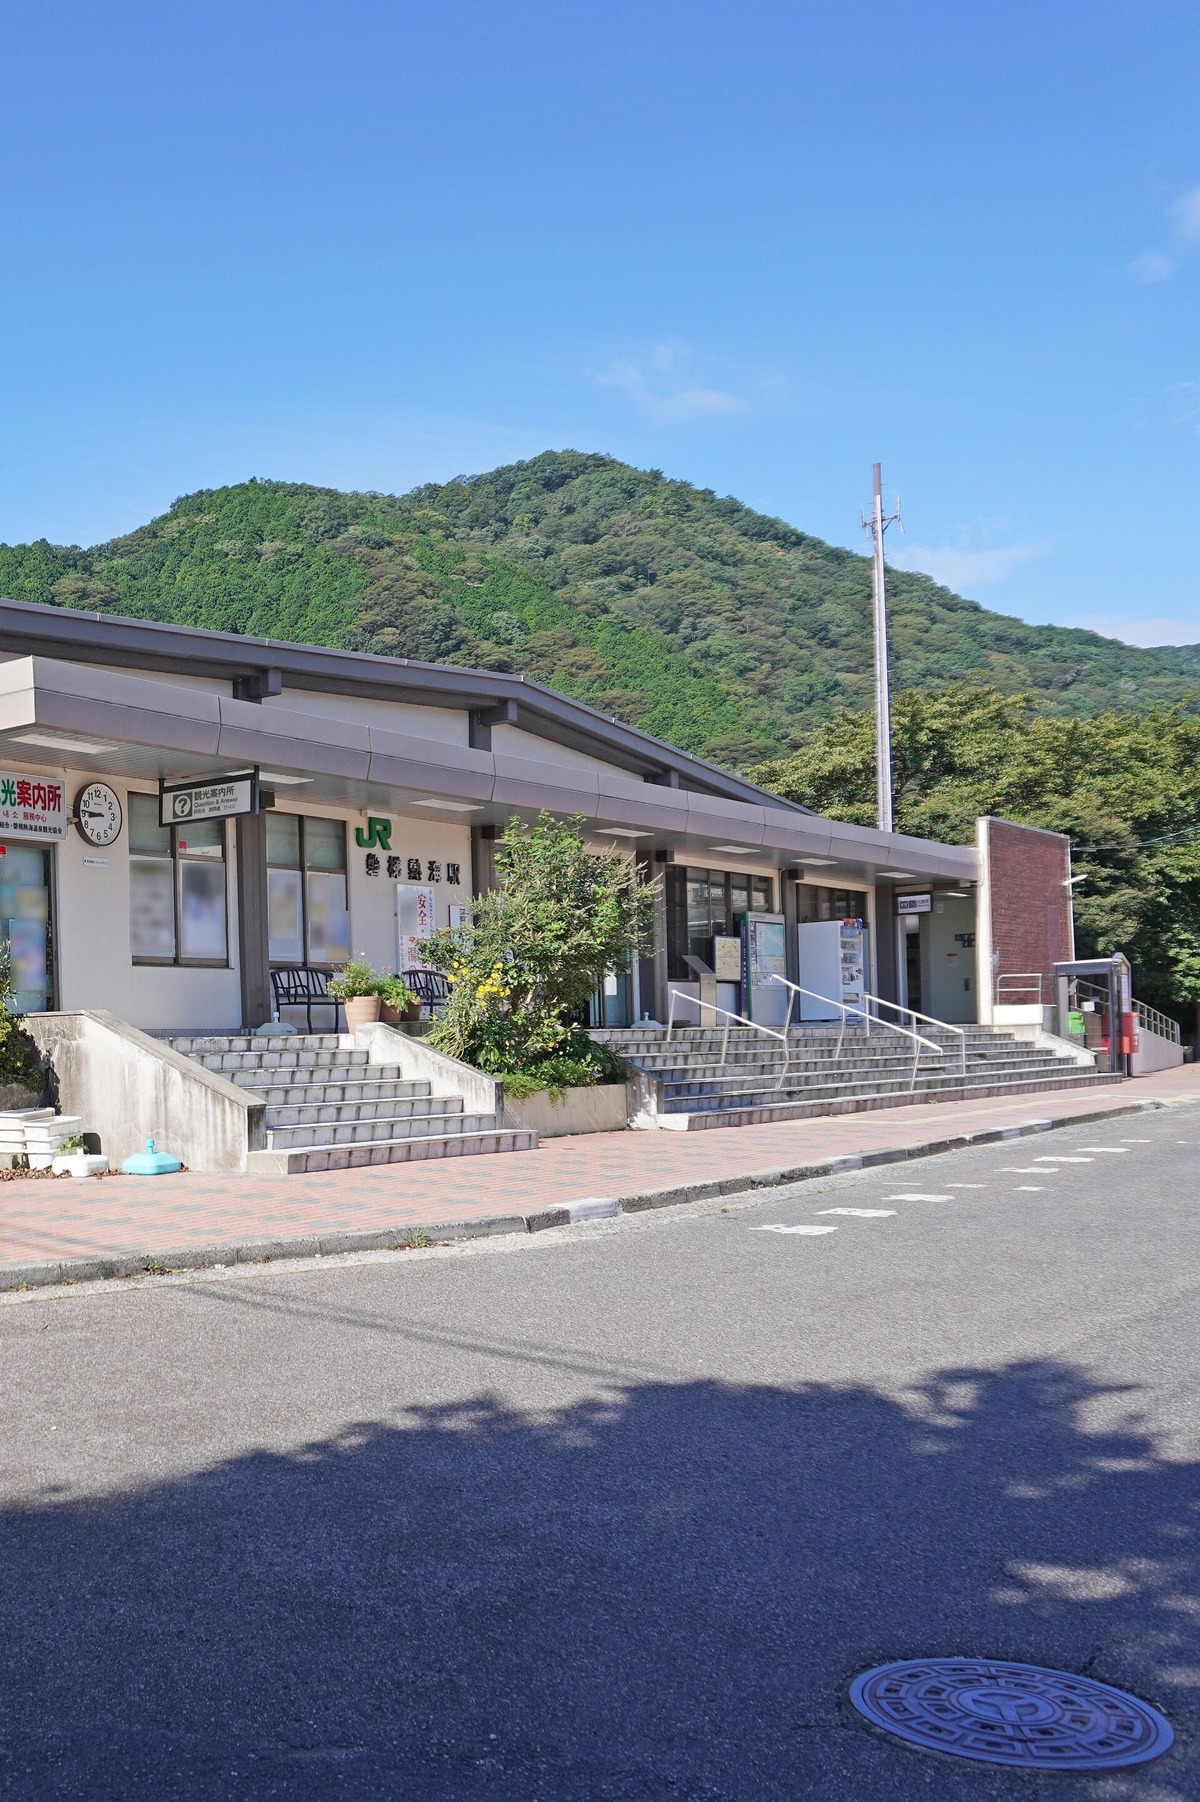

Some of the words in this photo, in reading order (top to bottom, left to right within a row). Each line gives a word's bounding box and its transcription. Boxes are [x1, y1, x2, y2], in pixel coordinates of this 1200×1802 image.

[87, 792, 93, 800] 11
[94, 789, 101, 798] 12
[194, 785, 234, 801] 観光案内所
[82, 800, 90, 808] 10
[108, 801, 113, 811] 2
[193, 800, 215, 809] Question
[22, 811, 47, 823] 服務中心
[110, 813, 115, 821] 3
[83, 820, 89, 829] 8
[108, 823, 113, 831] 4
[90, 829, 95, 837] 7
[96, 832, 101, 840] 6
[103, 830, 108, 838] 5
[355, 816, 393, 851] JR
